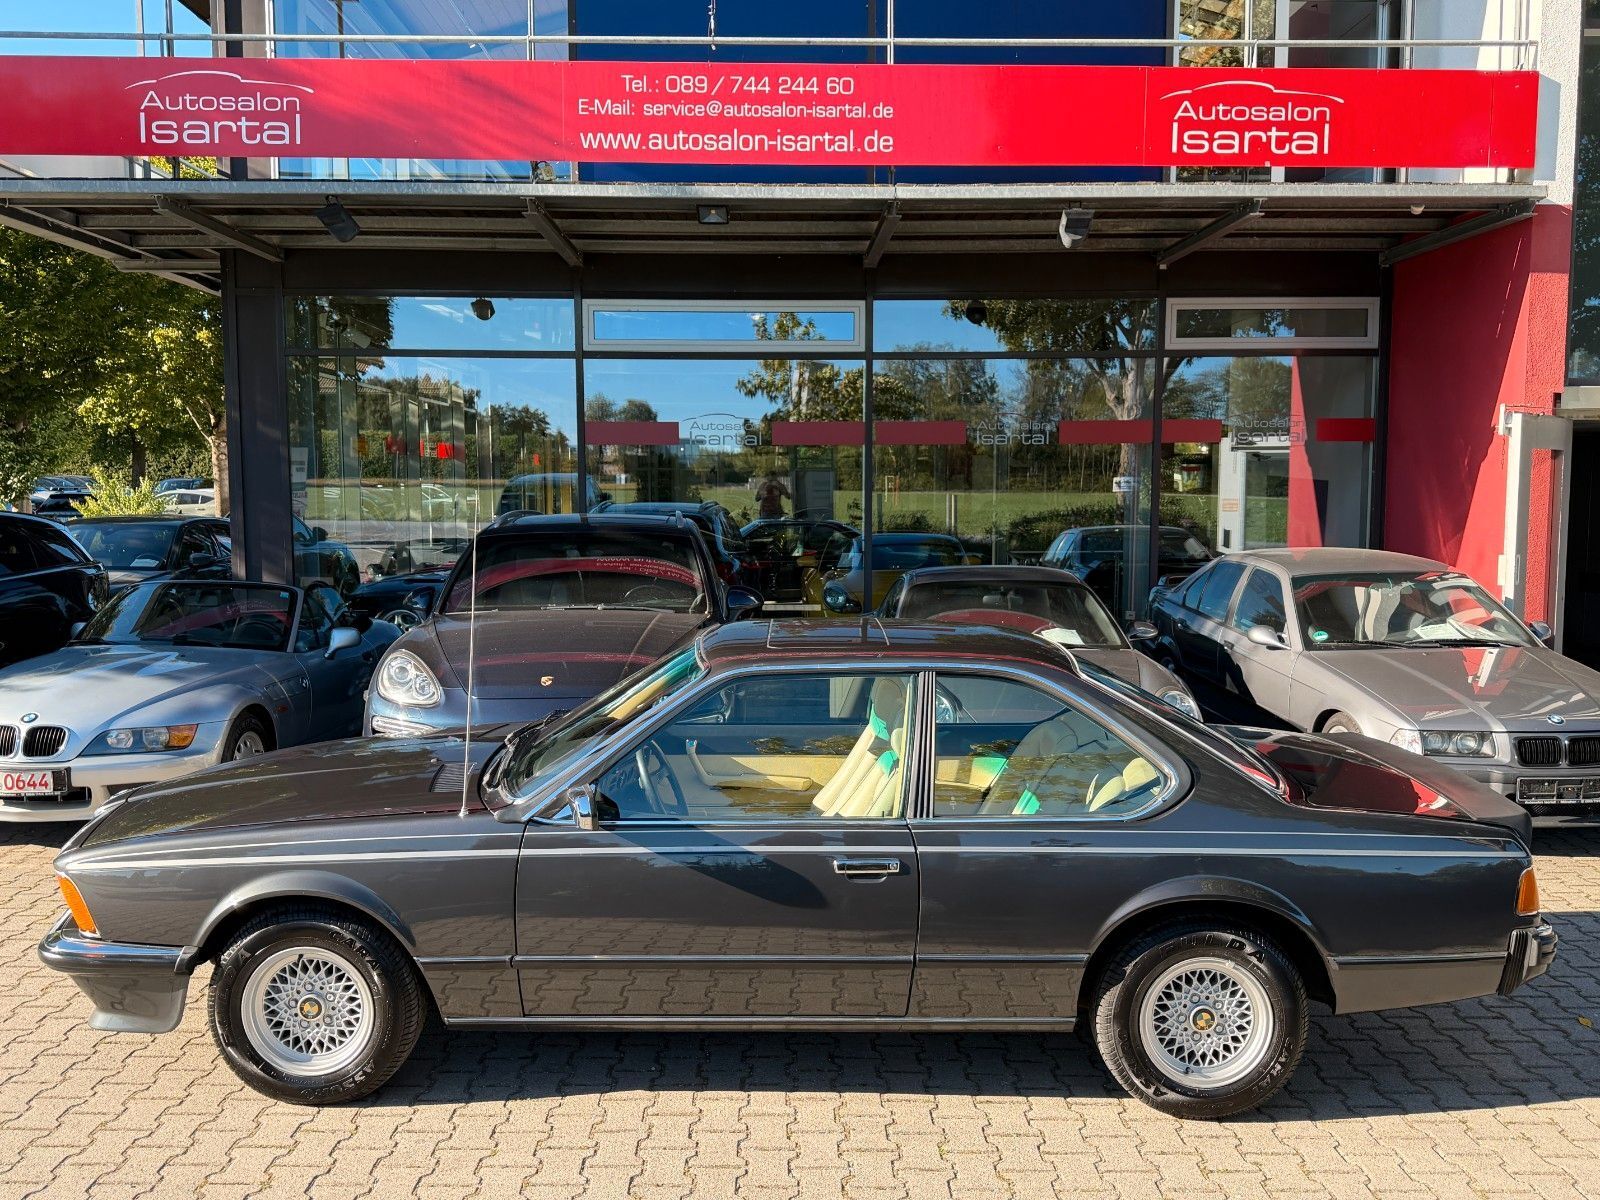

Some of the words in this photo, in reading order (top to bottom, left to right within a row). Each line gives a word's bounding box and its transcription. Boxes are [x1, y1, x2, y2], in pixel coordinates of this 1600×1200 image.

[621, 75, 659, 93] Tel.:
[665, 75, 707, 94] 089
[711, 76, 723, 94] /
[730, 76, 770, 94] 744
[778, 76, 819, 95] 244
[826, 77, 854, 95] 60
[140, 90, 300, 111] Autosalon
[578, 98, 635, 116] E-Mail:
[643, 100, 894, 119] service@autosalon-isartal.de
[1173, 100, 1330, 121] Autosalon
[140, 112, 301, 145] Isartal
[1171, 121, 1330, 155] Isartal
[580, 128, 894, 153] www.autosalon-isartal.de
[689, 430, 762, 446] Isartal
[976, 430, 1050, 445] Isartal
[1231, 428, 1306, 443] Isartal
[4, 773, 49, 790] 0644
